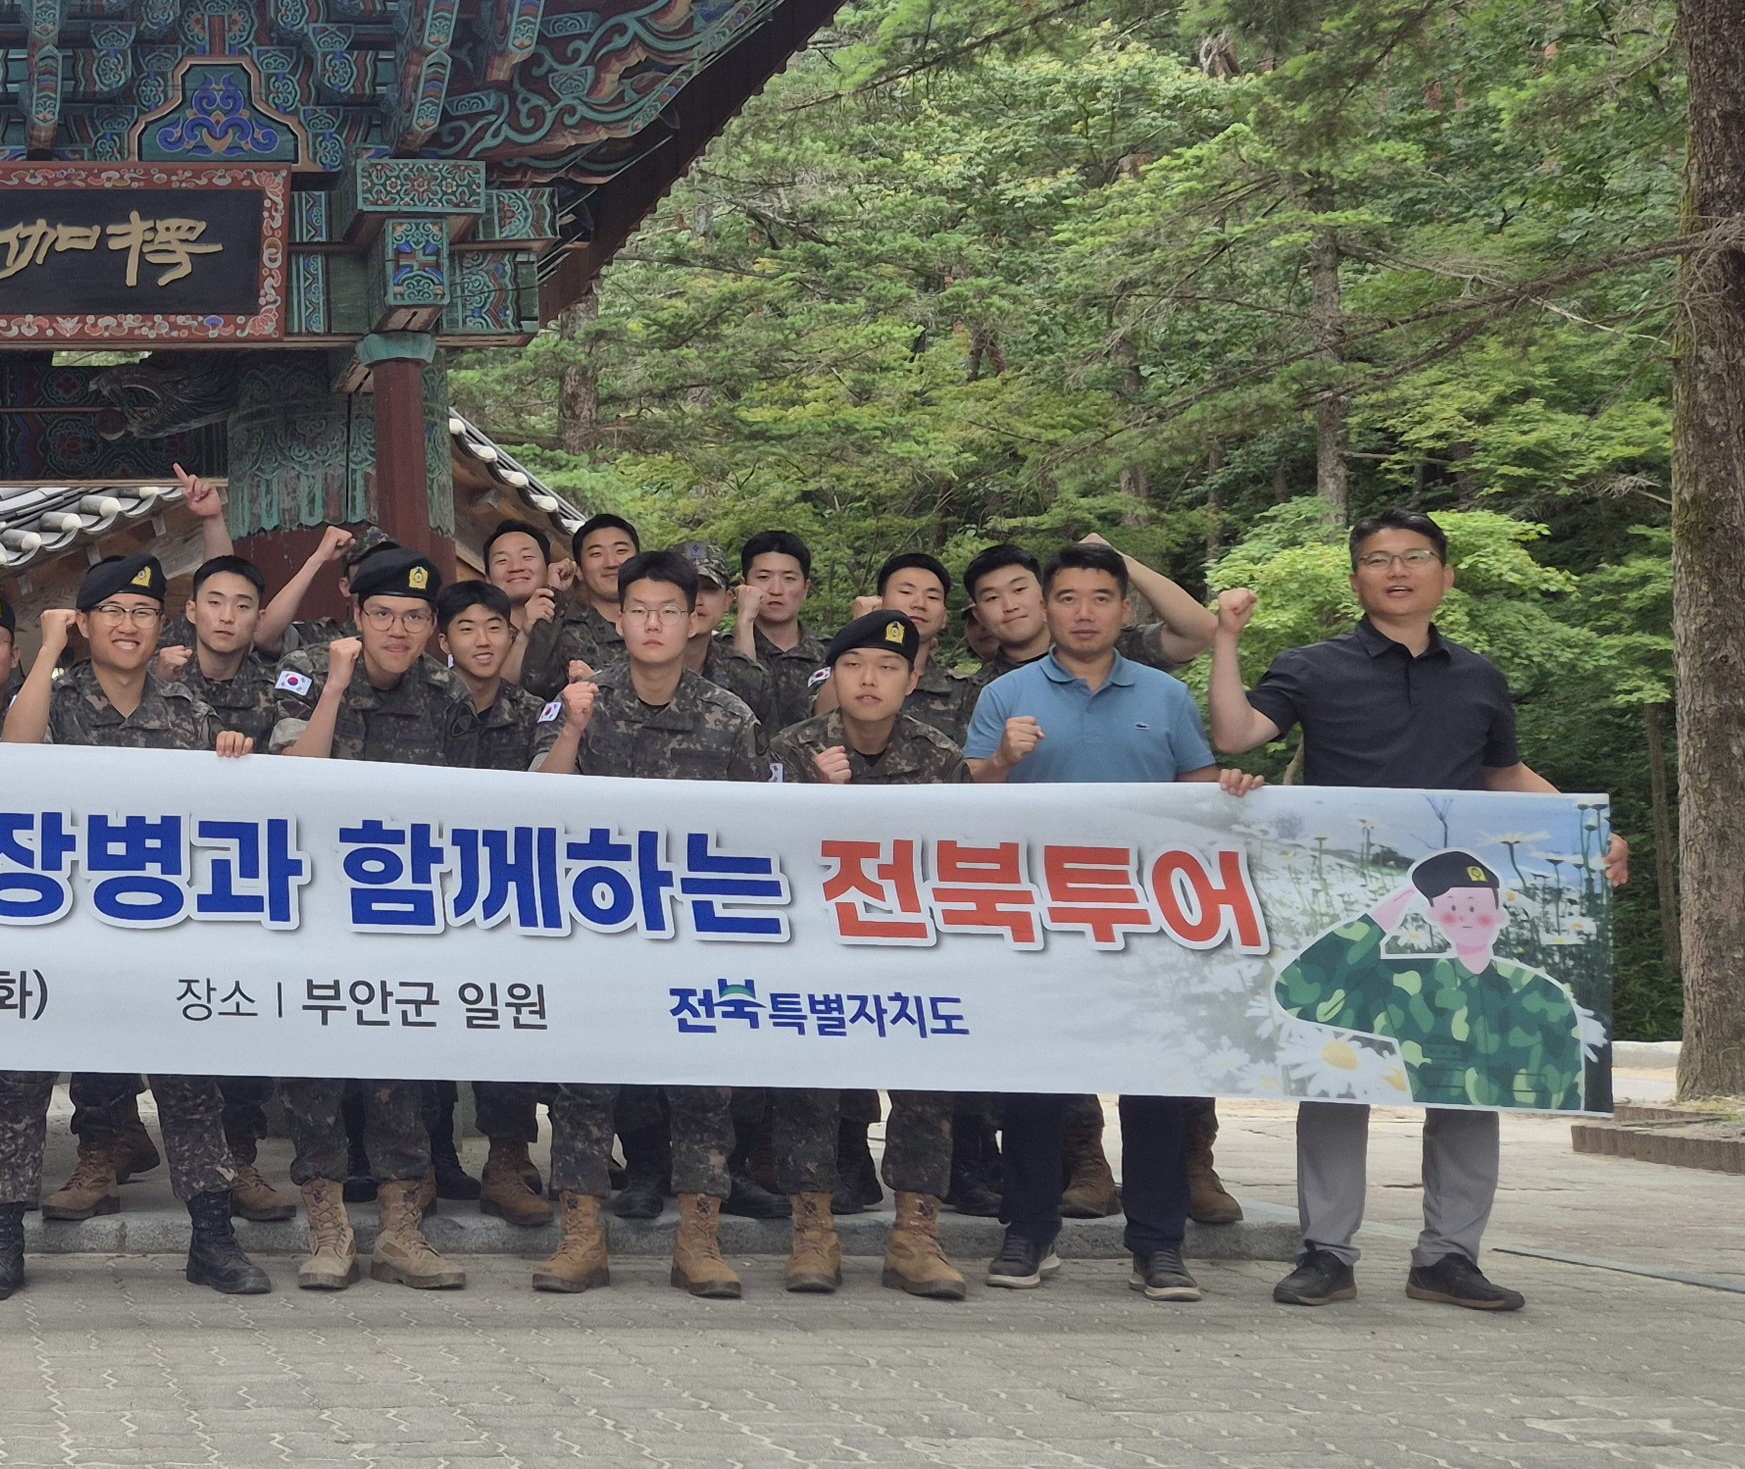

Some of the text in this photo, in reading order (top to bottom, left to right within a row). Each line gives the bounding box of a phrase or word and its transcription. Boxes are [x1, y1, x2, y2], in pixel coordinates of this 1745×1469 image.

[339, 817, 783, 936] 함께하는
[821, 839, 1261, 949] 전북투어
[175, 977, 260, 1023] 장소
[301, 978, 441, 1029] 부안군
[457, 980, 549, 1031] 일원
